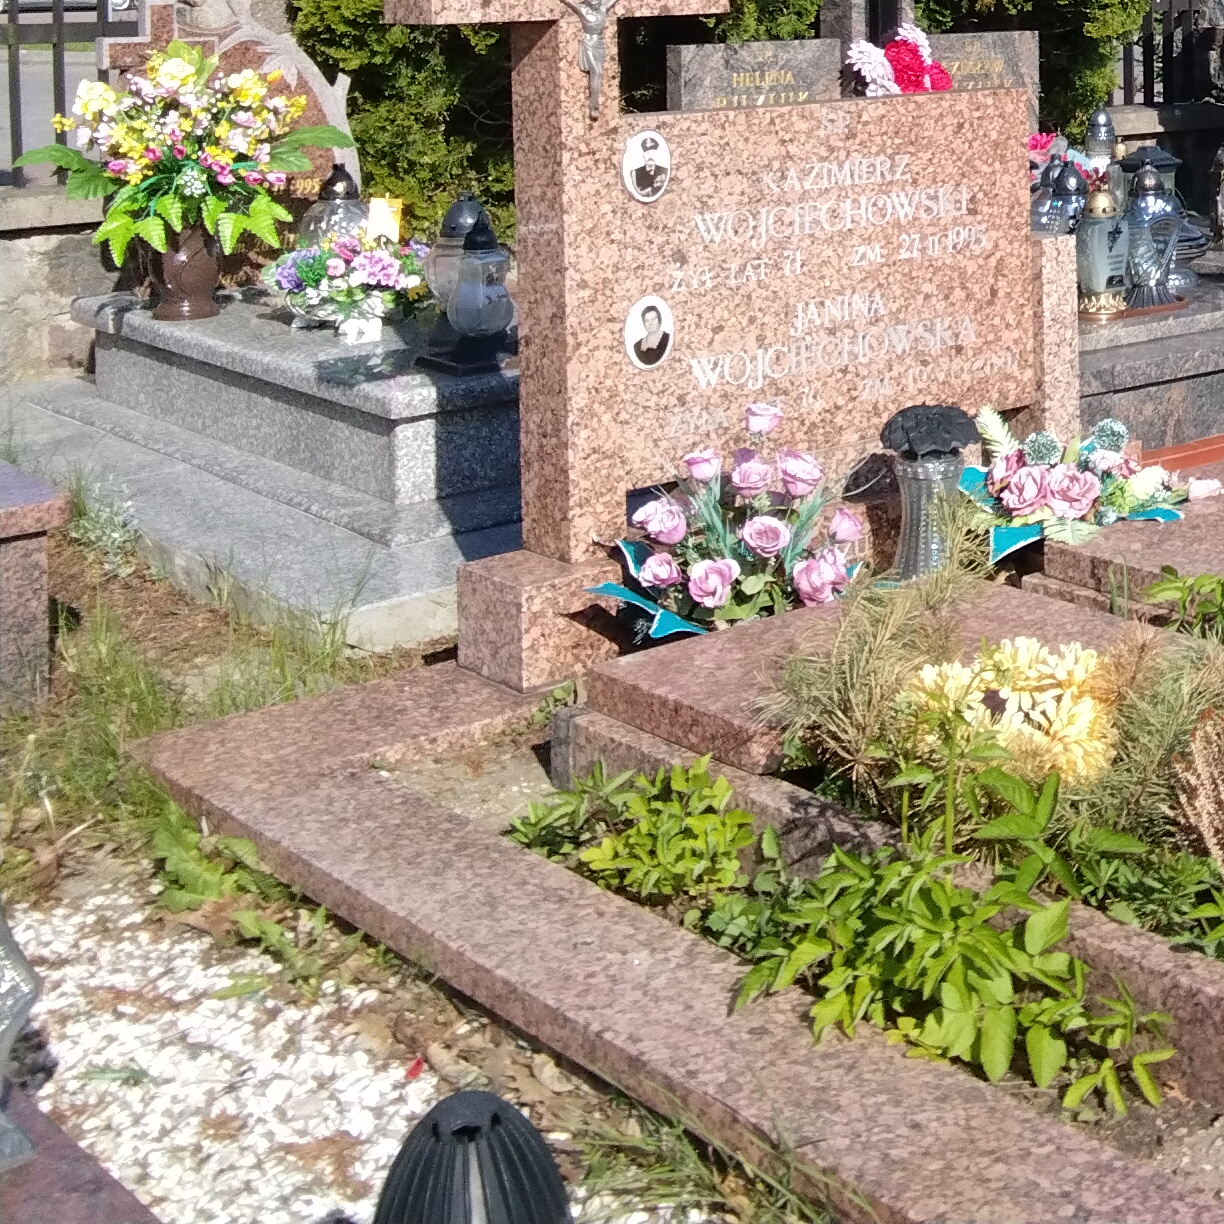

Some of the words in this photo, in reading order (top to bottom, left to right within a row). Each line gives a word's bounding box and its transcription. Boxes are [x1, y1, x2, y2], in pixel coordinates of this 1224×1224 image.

[732, 70, 796, 88] HELENA
[693, 185, 969, 248] WOJCIECHOWSKI
[730, 258, 769, 284] LAT
[783, 249, 801, 276] 71
[898, 234, 921, 260] 27
[790, 292, 886, 336] JANINA
[690, 316, 977, 389] WOJCIECHOWSKA
